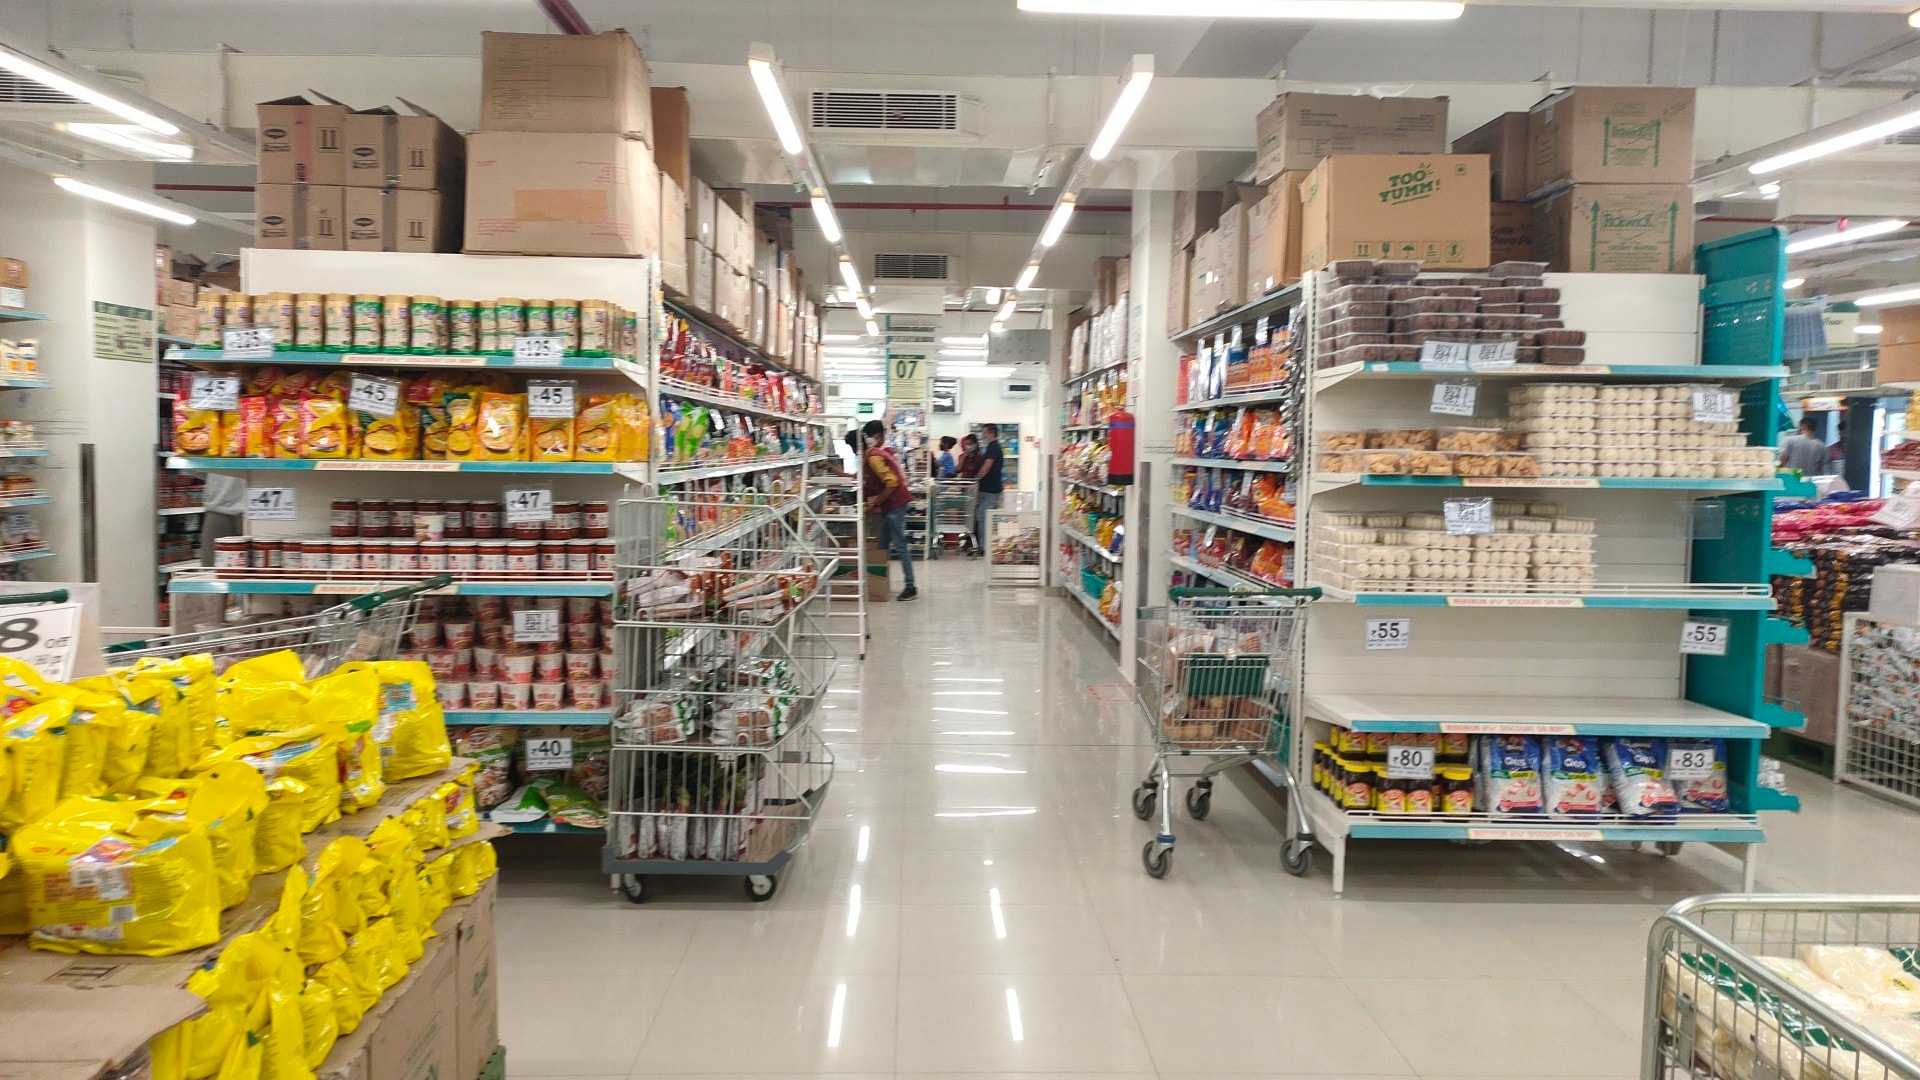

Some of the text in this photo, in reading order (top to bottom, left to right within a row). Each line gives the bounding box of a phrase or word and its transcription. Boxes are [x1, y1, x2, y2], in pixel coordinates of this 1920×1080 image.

[1389, 169, 1427, 187] TOO
[1379, 179, 1440, 202] YUMM!
[896, 359, 918, 379] 07
[0, 617, 39, 653] 8
